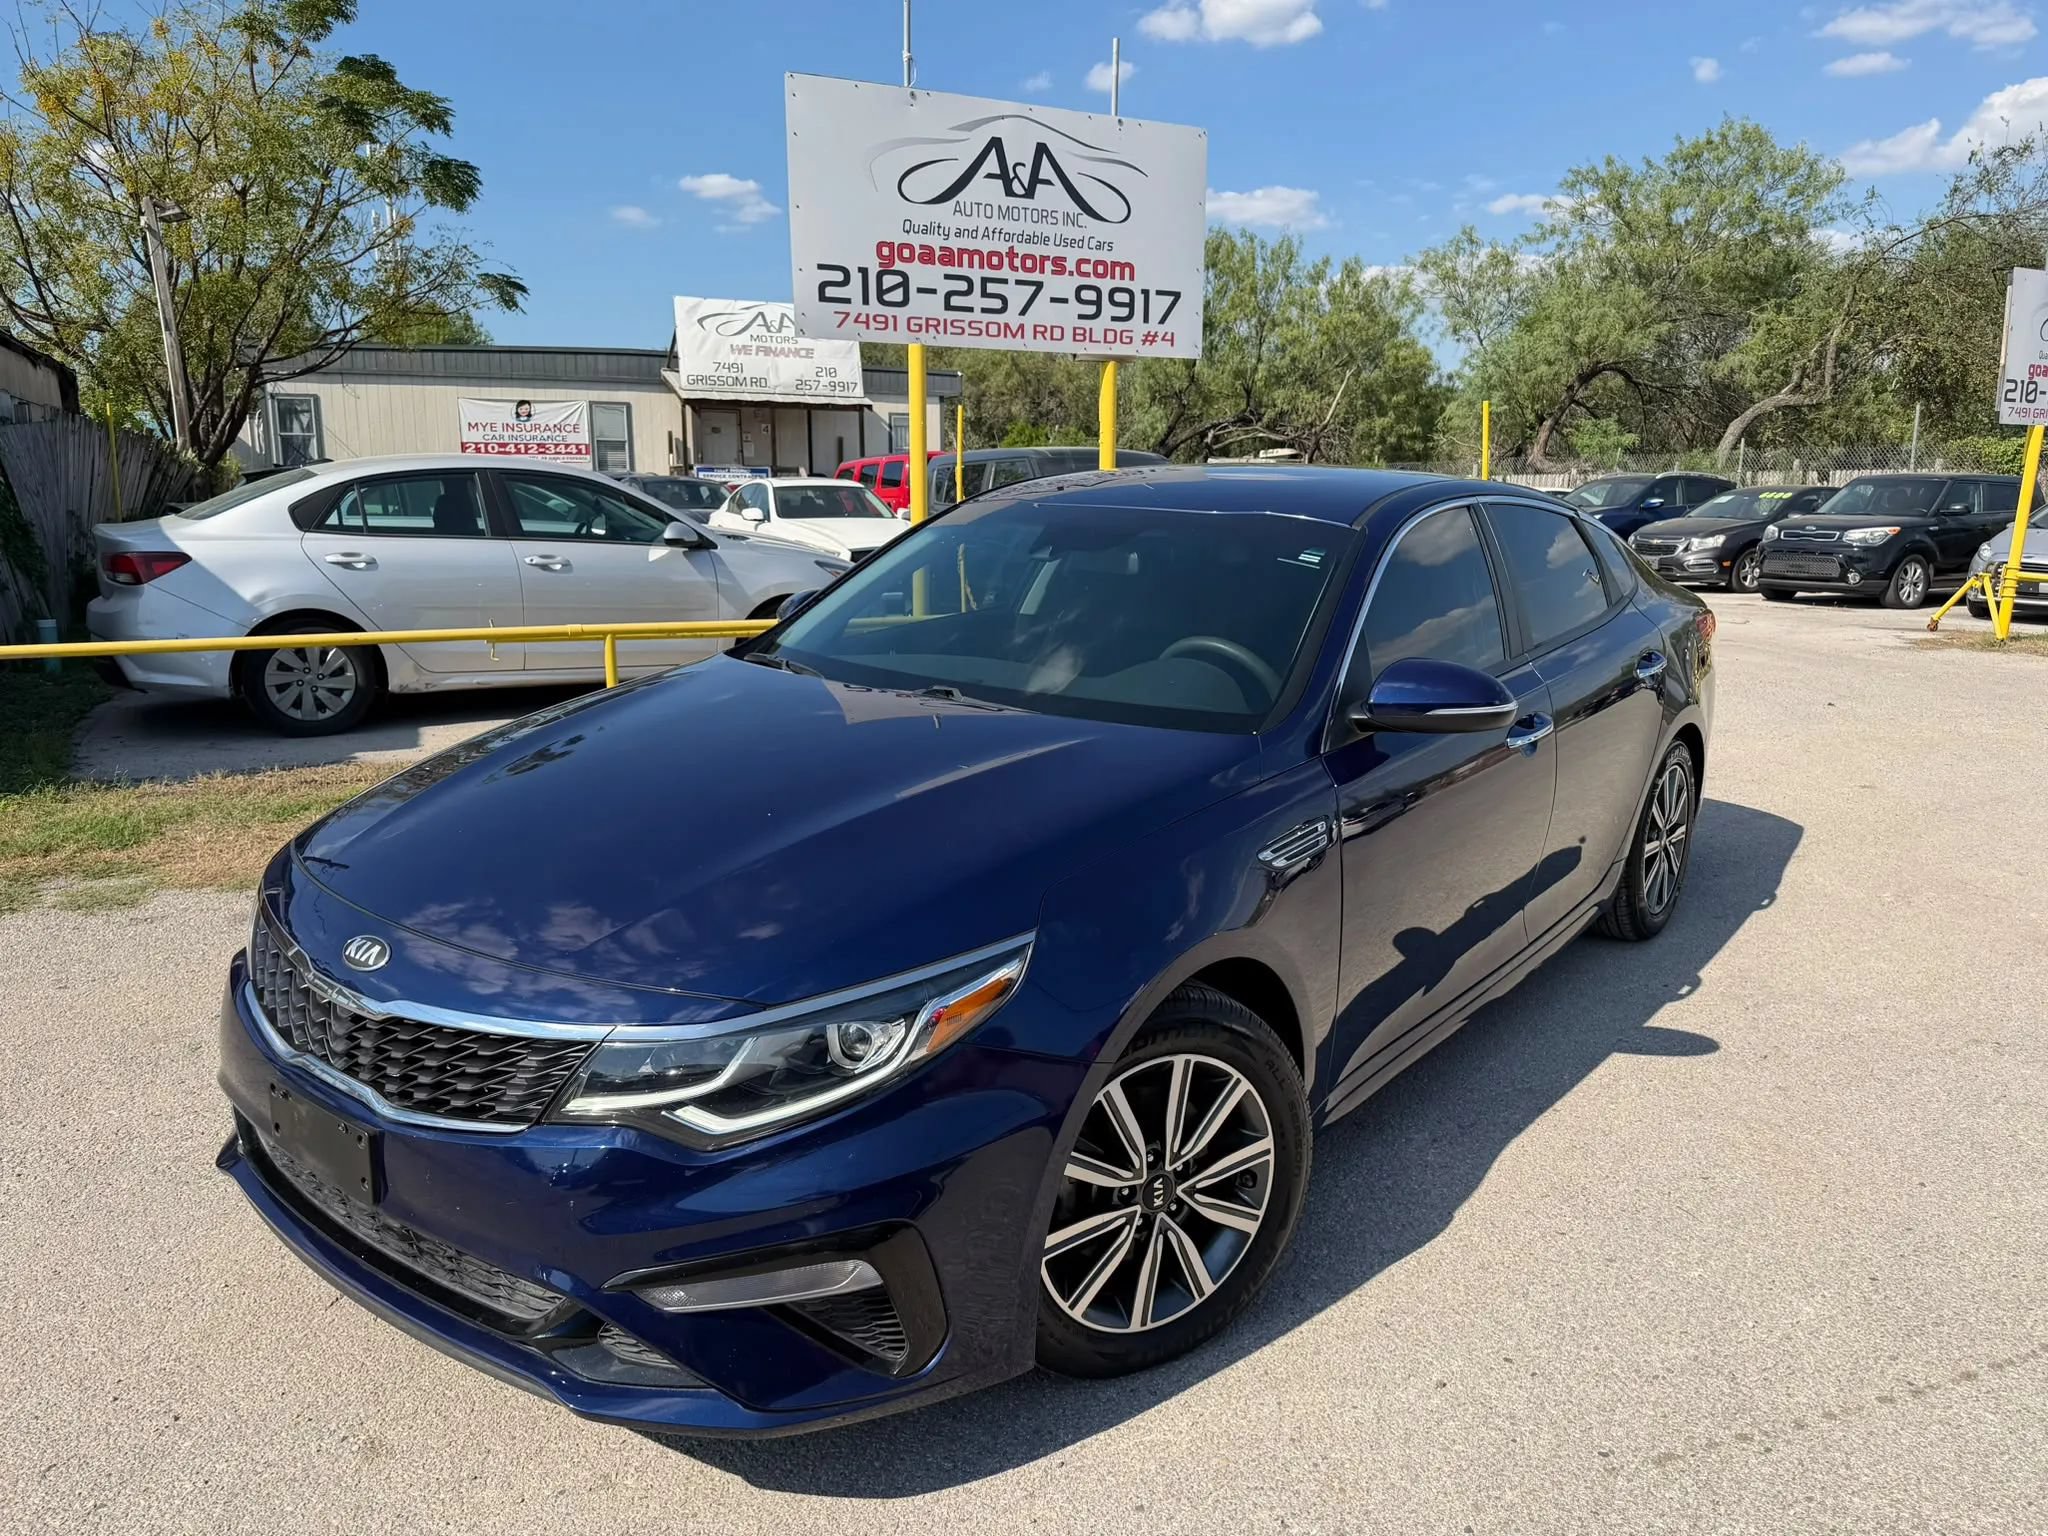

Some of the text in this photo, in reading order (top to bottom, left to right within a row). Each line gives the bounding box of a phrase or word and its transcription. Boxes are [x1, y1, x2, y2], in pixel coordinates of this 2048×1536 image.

[900, 136, 1127, 220] A&A
[952, 199, 1088, 229] AUTO MOTORS INC.
[902, 217, 1114, 252] Quality and Affordable Used Cars
[875, 240, 1136, 281] goaamotors.com
[816, 263, 1182, 326] 210-257-9917
[833, 310, 1176, 348] 7491 GRISSOM RD BLDG #4
[749, 334, 799, 345] MOTORS
[730, 344, 815, 359] WE FINANCE
[712, 361, 744, 374] 7491
[815, 366, 838, 378] 210
[686, 374, 748, 388] GRISSOM
[794, 378, 858, 393] 257-9917
[2008, 406, 2031, 418] 7491
[467, 422, 581, 434] MYE INSURANCE
[482, 433, 568, 443] CAR INSURANCE
[464, 443, 588, 455] 210-412-3441
[346, 937, 382, 966] KIA
[1153, 1178, 1165, 1207] KIA
